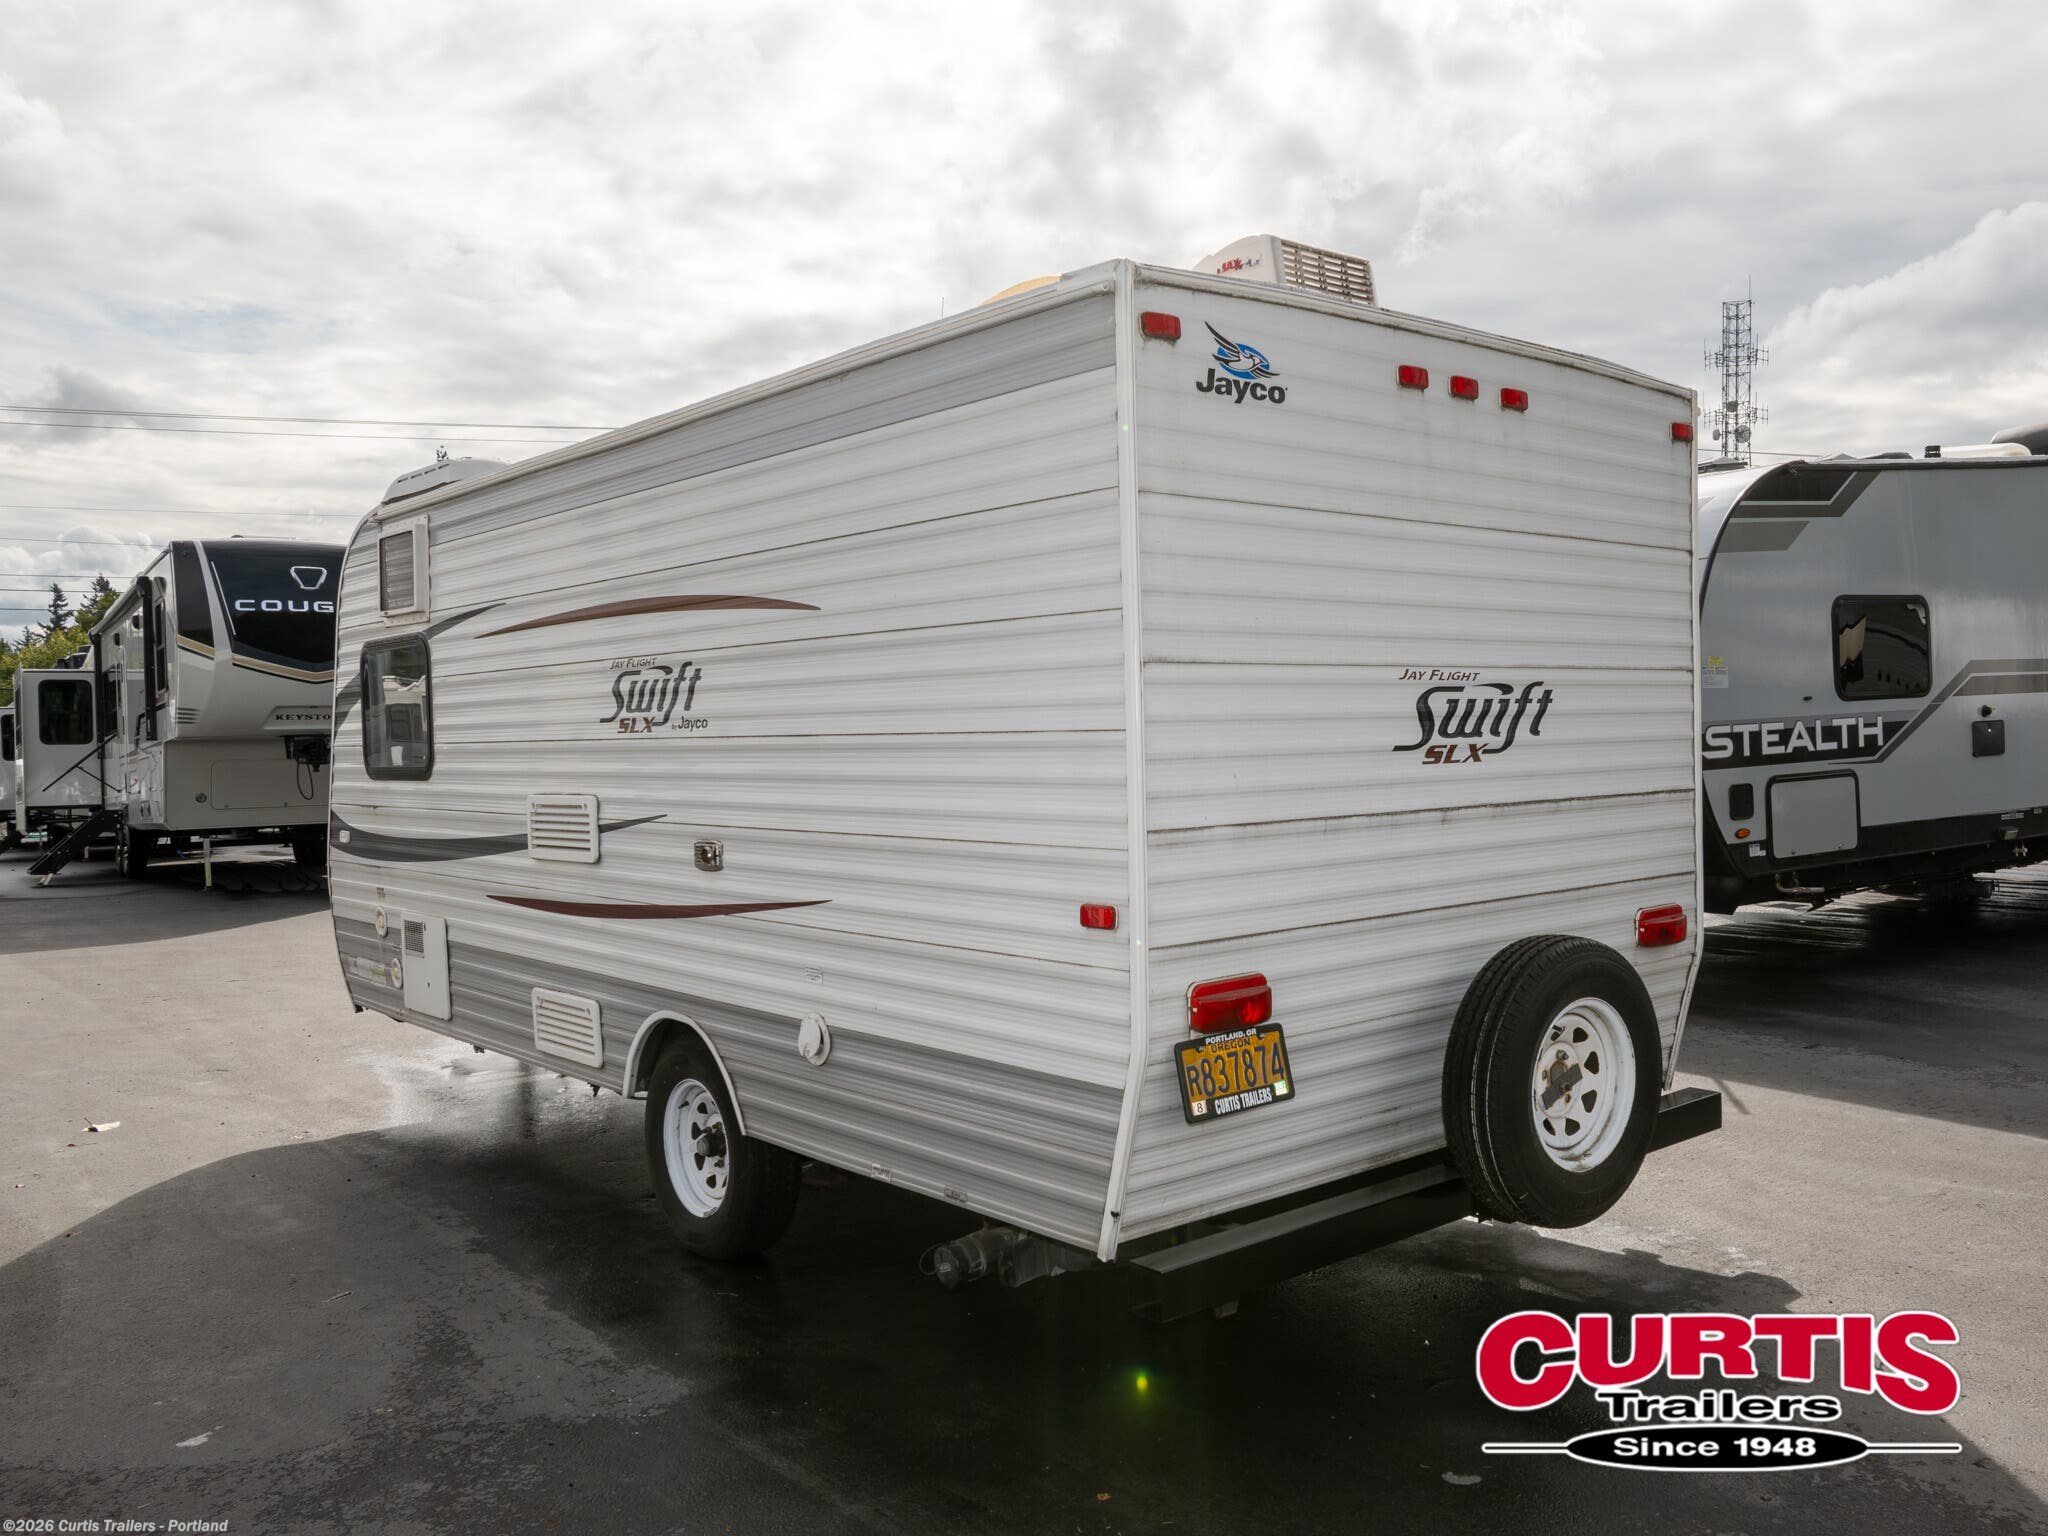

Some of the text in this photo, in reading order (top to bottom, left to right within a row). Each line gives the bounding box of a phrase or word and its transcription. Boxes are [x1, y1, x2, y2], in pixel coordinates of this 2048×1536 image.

[1195, 367, 1286, 404] Jayco
[234, 599, 335, 613] COUG
[600, 661, 702, 726] Swift
[275, 713, 331, 721] KEYSTO
[617, 716, 656, 734] SLX
[678, 716, 708, 732] Jayco
[1392, 681, 1553, 755] Swift
[1702, 716, 1884, 760] STEALTH
[1422, 743, 1490, 765] SLX
[1246, 1028, 1257, 1036] OR
[1210, 1038, 1251, 1053] OREGON
[1186, 1043, 1285, 1097] R837874
[1214, 1095, 1241, 1115] CURTIS
[1241, 1087, 1273, 1110] TRAILERS
